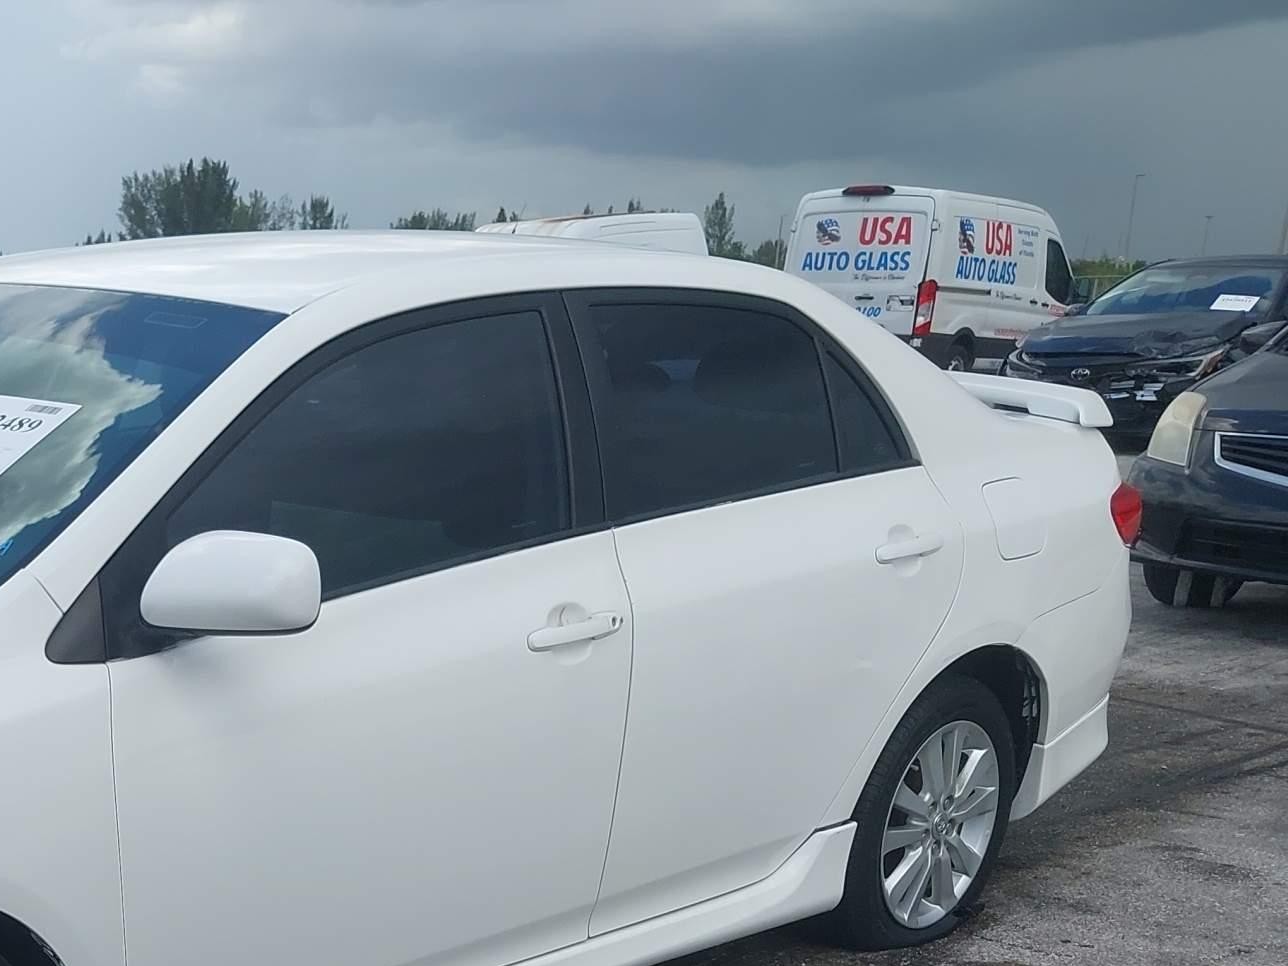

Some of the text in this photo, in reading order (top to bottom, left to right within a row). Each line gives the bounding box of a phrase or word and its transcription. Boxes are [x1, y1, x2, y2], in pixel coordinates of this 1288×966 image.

[859, 216, 912, 246] USA
[985, 220, 1013, 256] USA
[801, 251, 911, 271] AUTO GLASS
[955, 255, 1017, 285] AUTO GLASS
